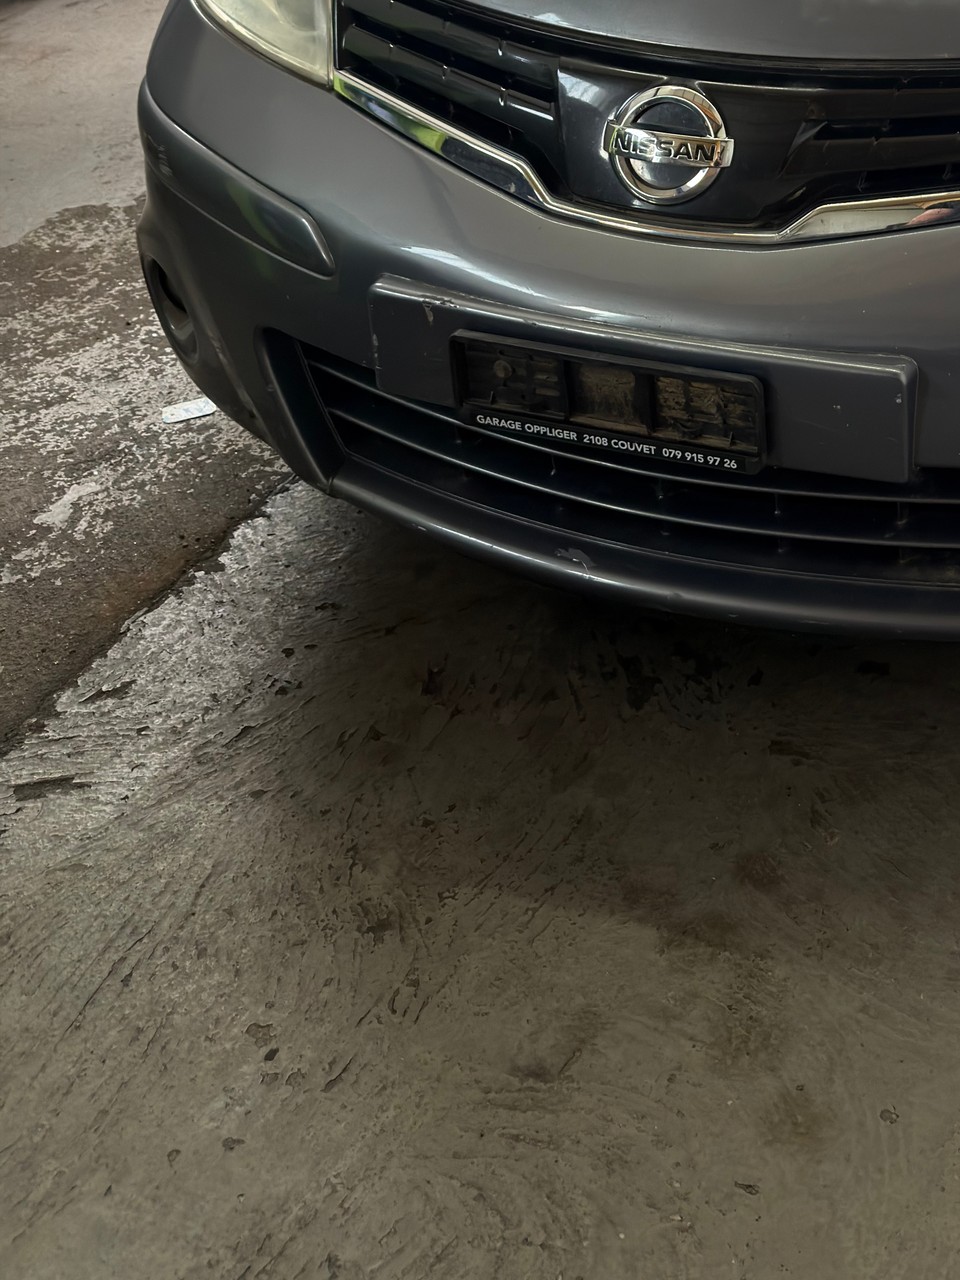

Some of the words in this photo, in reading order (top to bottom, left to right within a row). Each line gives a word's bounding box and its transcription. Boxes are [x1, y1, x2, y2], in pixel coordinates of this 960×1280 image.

[612, 128, 716, 162] NISSAN
[476, 414, 522, 431] GARAGE
[524, 423, 578, 441] OPPLIGER
[583, 434, 608, 446] 2108
[611, 439, 656, 455] COUVET
[662, 447, 682, 459] 079
[684, 451, 705, 463] 915
[706, 455, 721, 466] 97
[723, 458, 738, 469] 26
